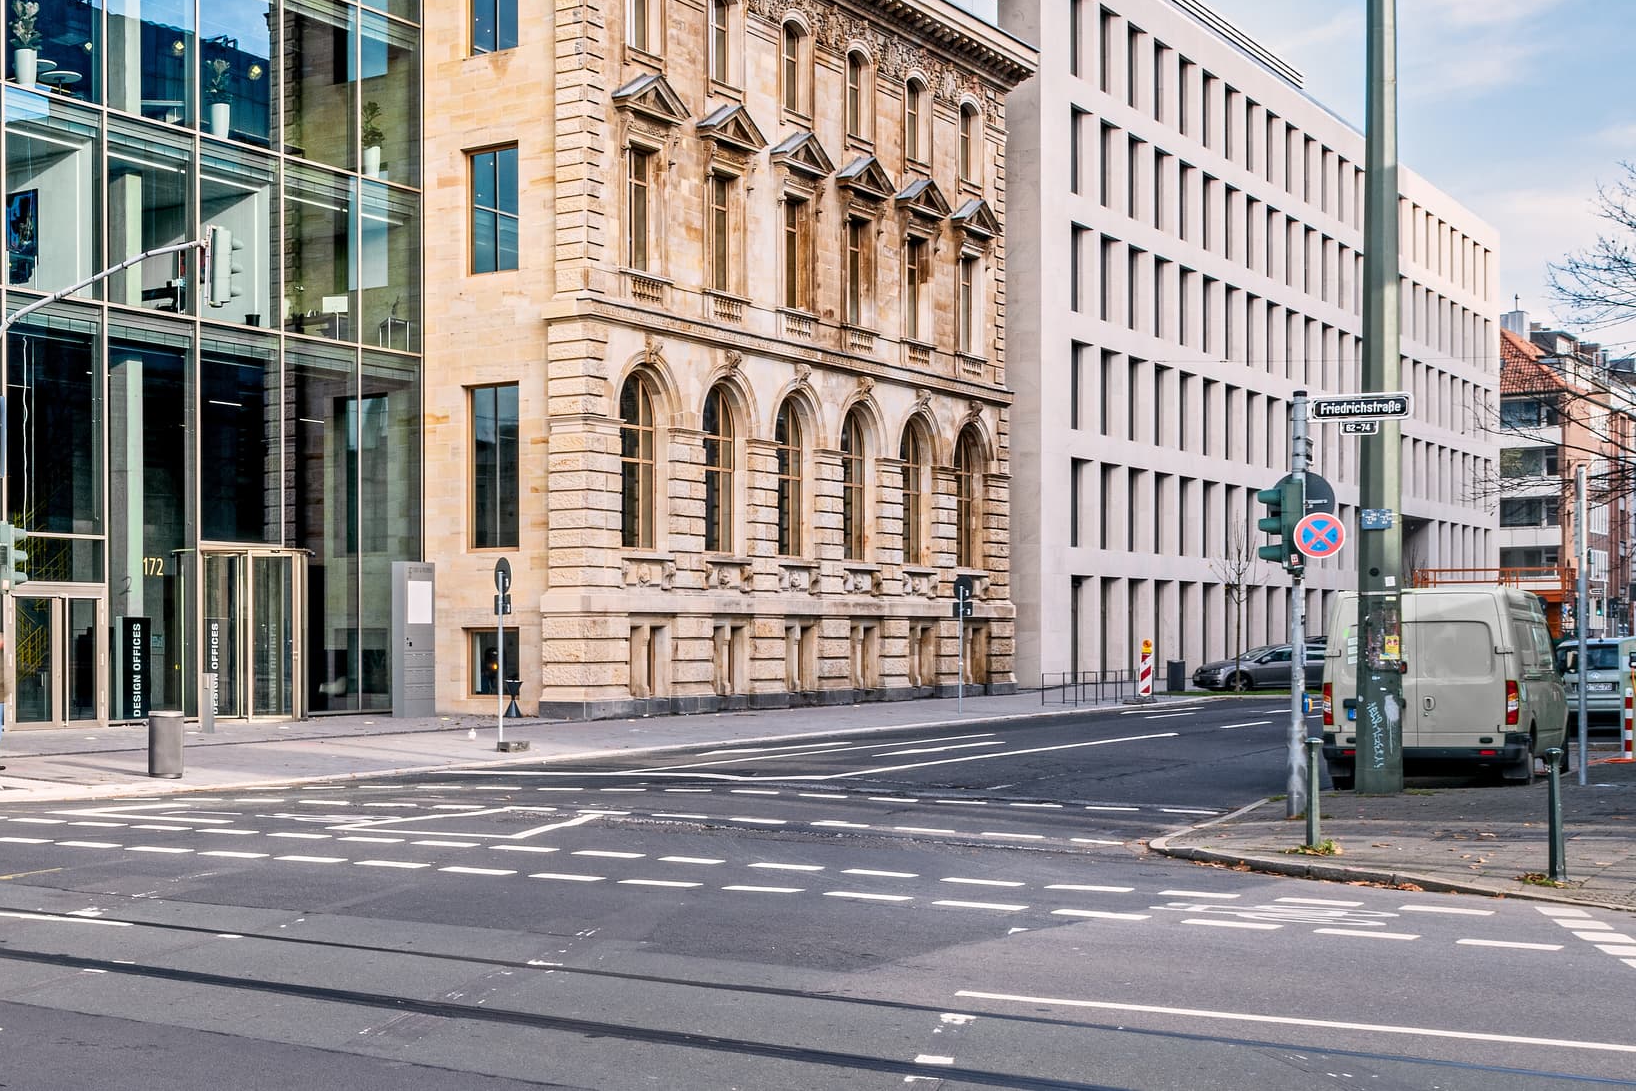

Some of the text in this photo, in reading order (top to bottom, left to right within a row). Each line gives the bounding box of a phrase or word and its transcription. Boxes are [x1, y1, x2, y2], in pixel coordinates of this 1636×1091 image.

[1320, 400, 1402, 415] Friedrichstraße
[143, 557, 164, 576] 172
[133, 623, 141, 717] DESIGN OFFICES
